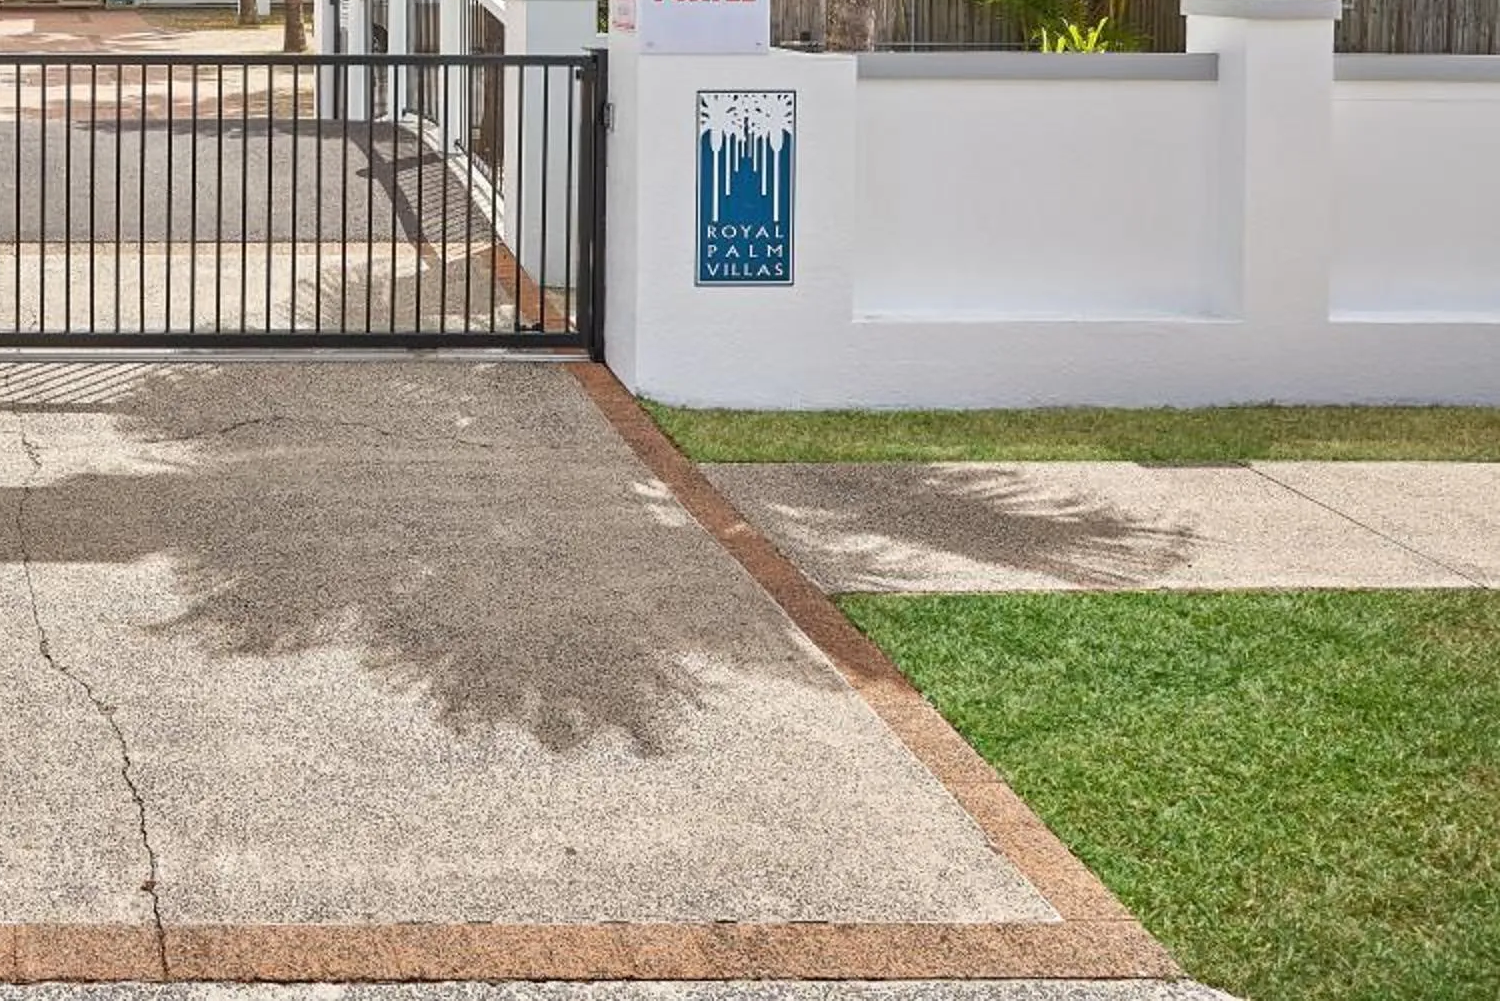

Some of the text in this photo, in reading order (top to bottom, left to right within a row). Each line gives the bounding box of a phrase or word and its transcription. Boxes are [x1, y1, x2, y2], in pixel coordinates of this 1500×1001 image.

[706, 224, 785, 240] ROYAL
[706, 243, 784, 258] PALM
[706, 262, 784, 277] VILLAS
